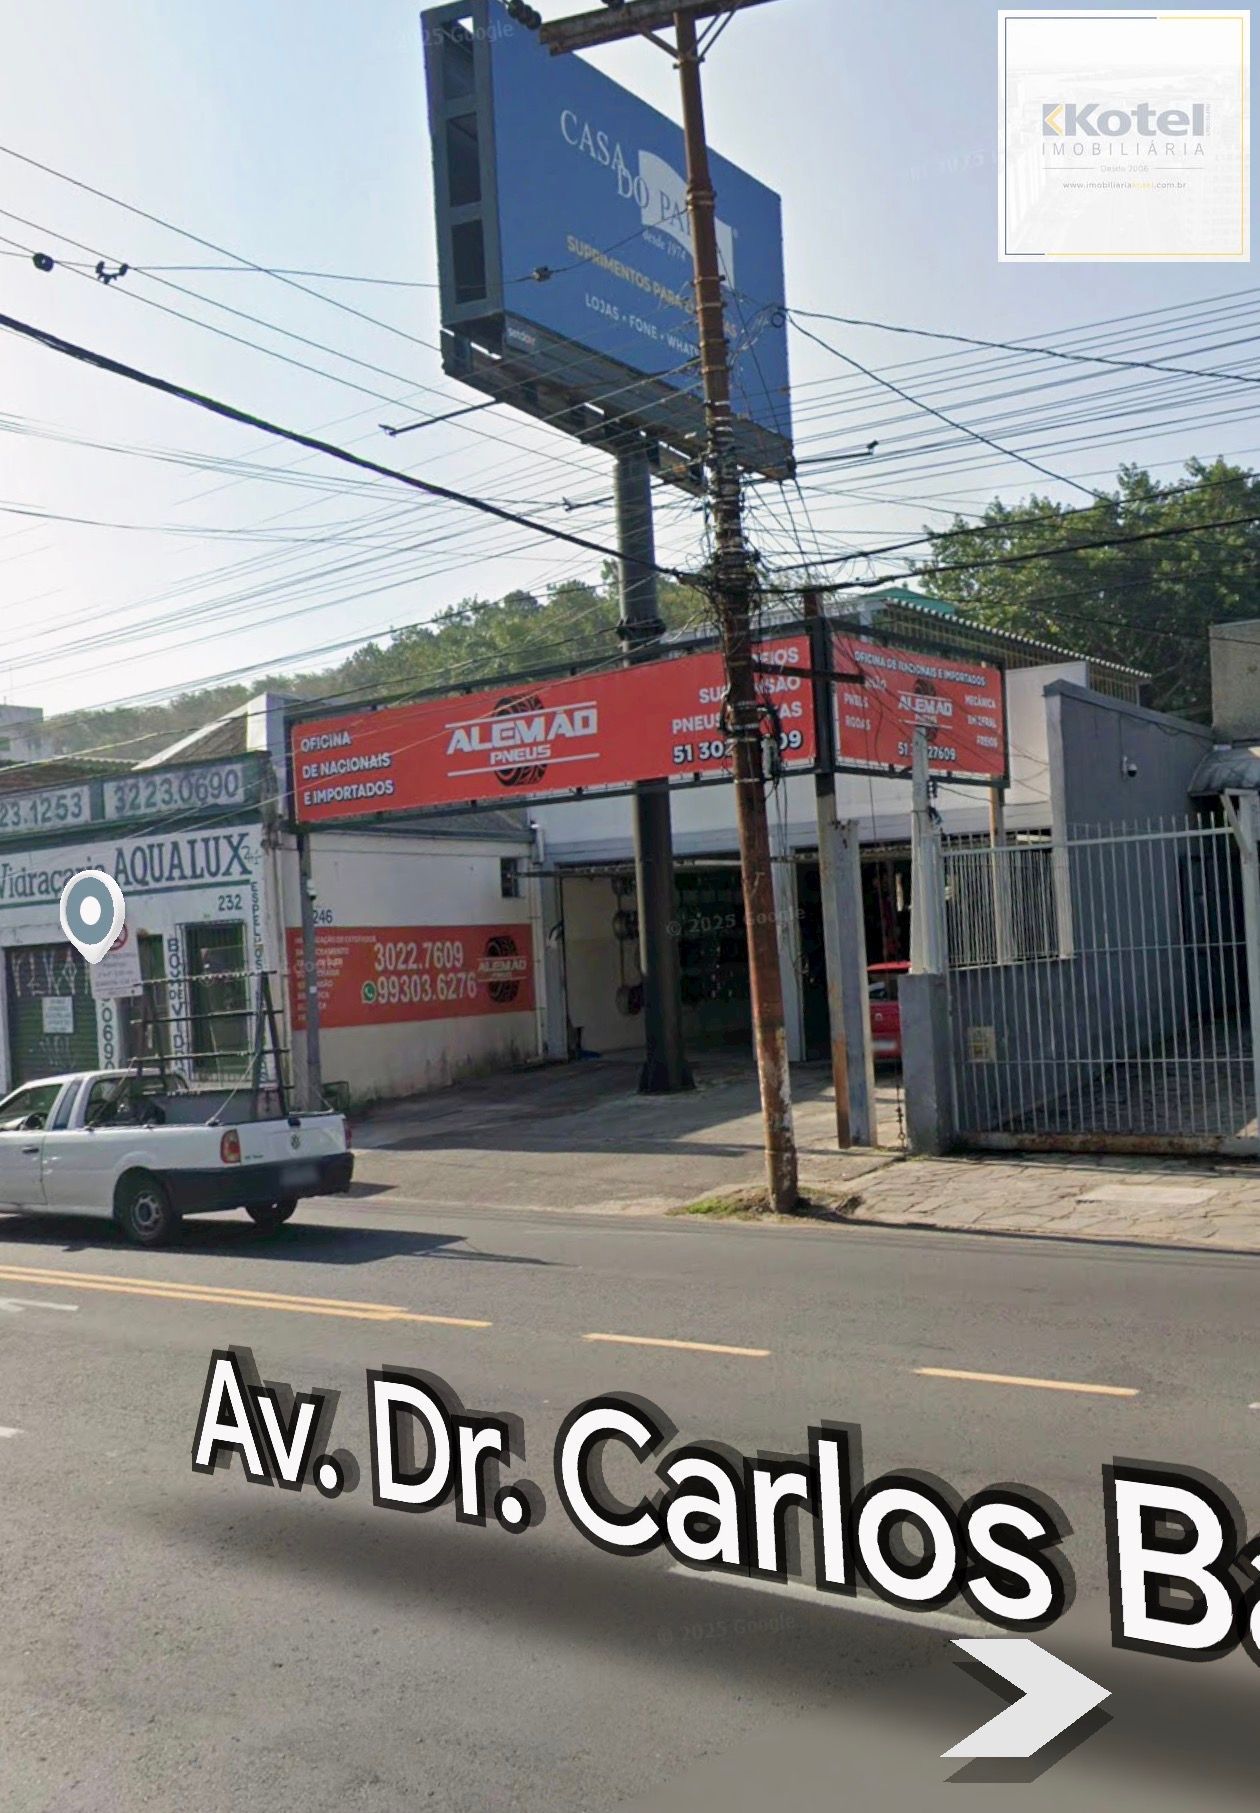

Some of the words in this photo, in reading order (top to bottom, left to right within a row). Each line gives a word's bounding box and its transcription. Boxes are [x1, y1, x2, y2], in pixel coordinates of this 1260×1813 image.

[561, 109, 627, 172] CASA
[617, 164, 649, 209] DO
[566, 235, 651, 293] SUPRIMENTOS
[585, 293, 619, 321] LOJAS
[629, 315, 657, 339] FONE
[943, 670, 987, 687] IMPORTADOS
[301, 730, 351, 754] OFICINA
[447, 708, 598, 755] ALEMÃO
[303, 763, 318, 779] DE
[320, 754, 391, 777] NACIONAIS
[490, 744, 551, 765] PNEUS
[673, 744, 694, 764] 51
[114, 769, 240, 814] 3223.0690
[304, 791, 311, 805] E
[313, 780, 394, 803] IMPORTADOS
[114, 832, 253, 886] AQUALUX
[218, 894, 243, 911] 232
[313, 909, 333, 924] 246
[374, 941, 465, 971] 3022.7609
[377, 972, 478, 1004] 99303.6276
